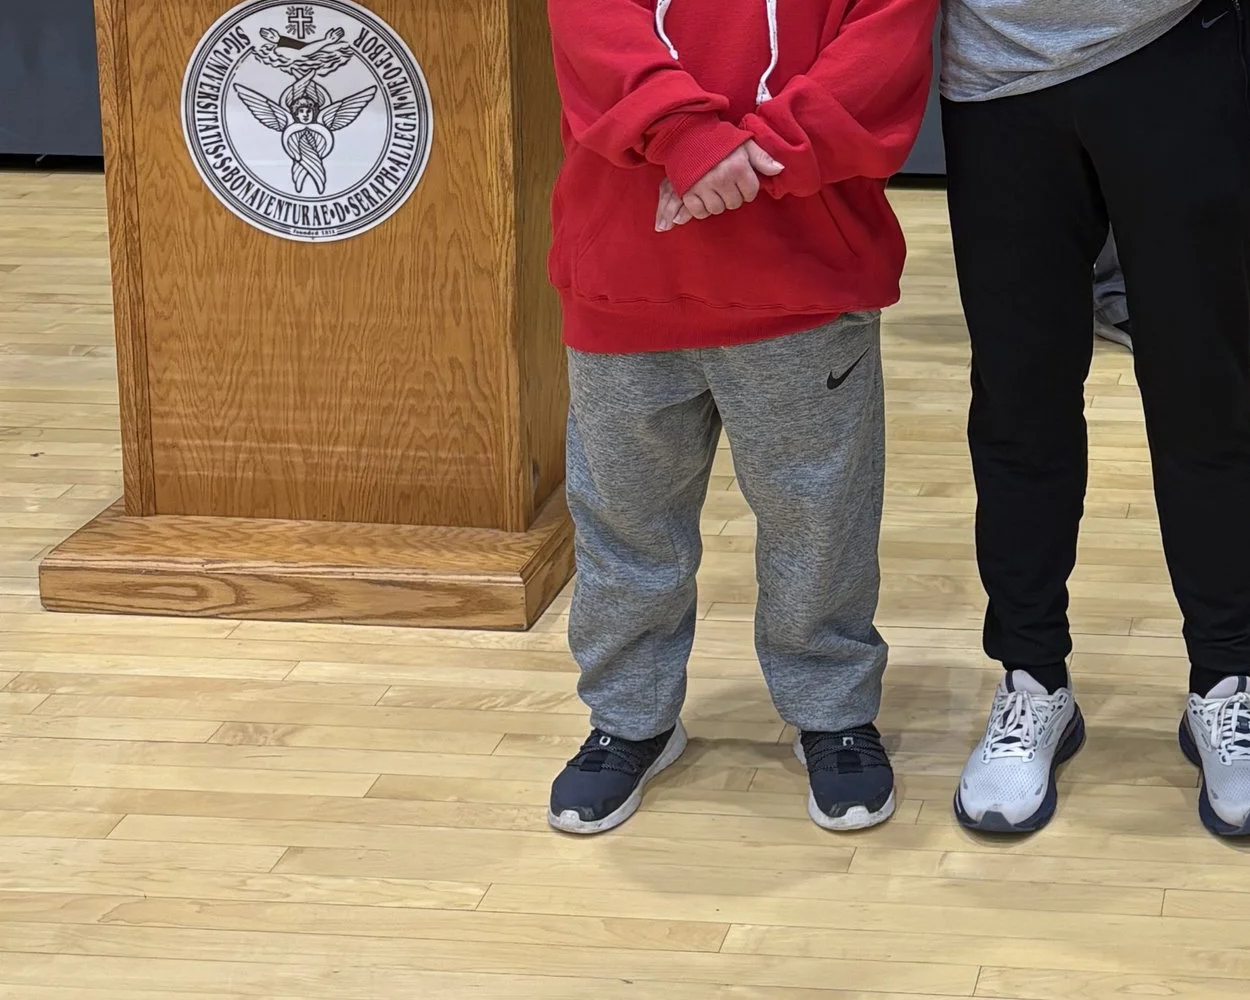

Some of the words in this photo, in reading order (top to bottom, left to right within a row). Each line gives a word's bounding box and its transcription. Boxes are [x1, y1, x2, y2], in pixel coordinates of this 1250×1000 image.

[221, 25, 251, 54] SIG
[353, 27, 394, 69] EBOR
[196, 49, 234, 156] UNIVERSITATIS
[221, 166, 332, 227] BONAVENTURAE
[347, 166, 401, 217] SERAPH
